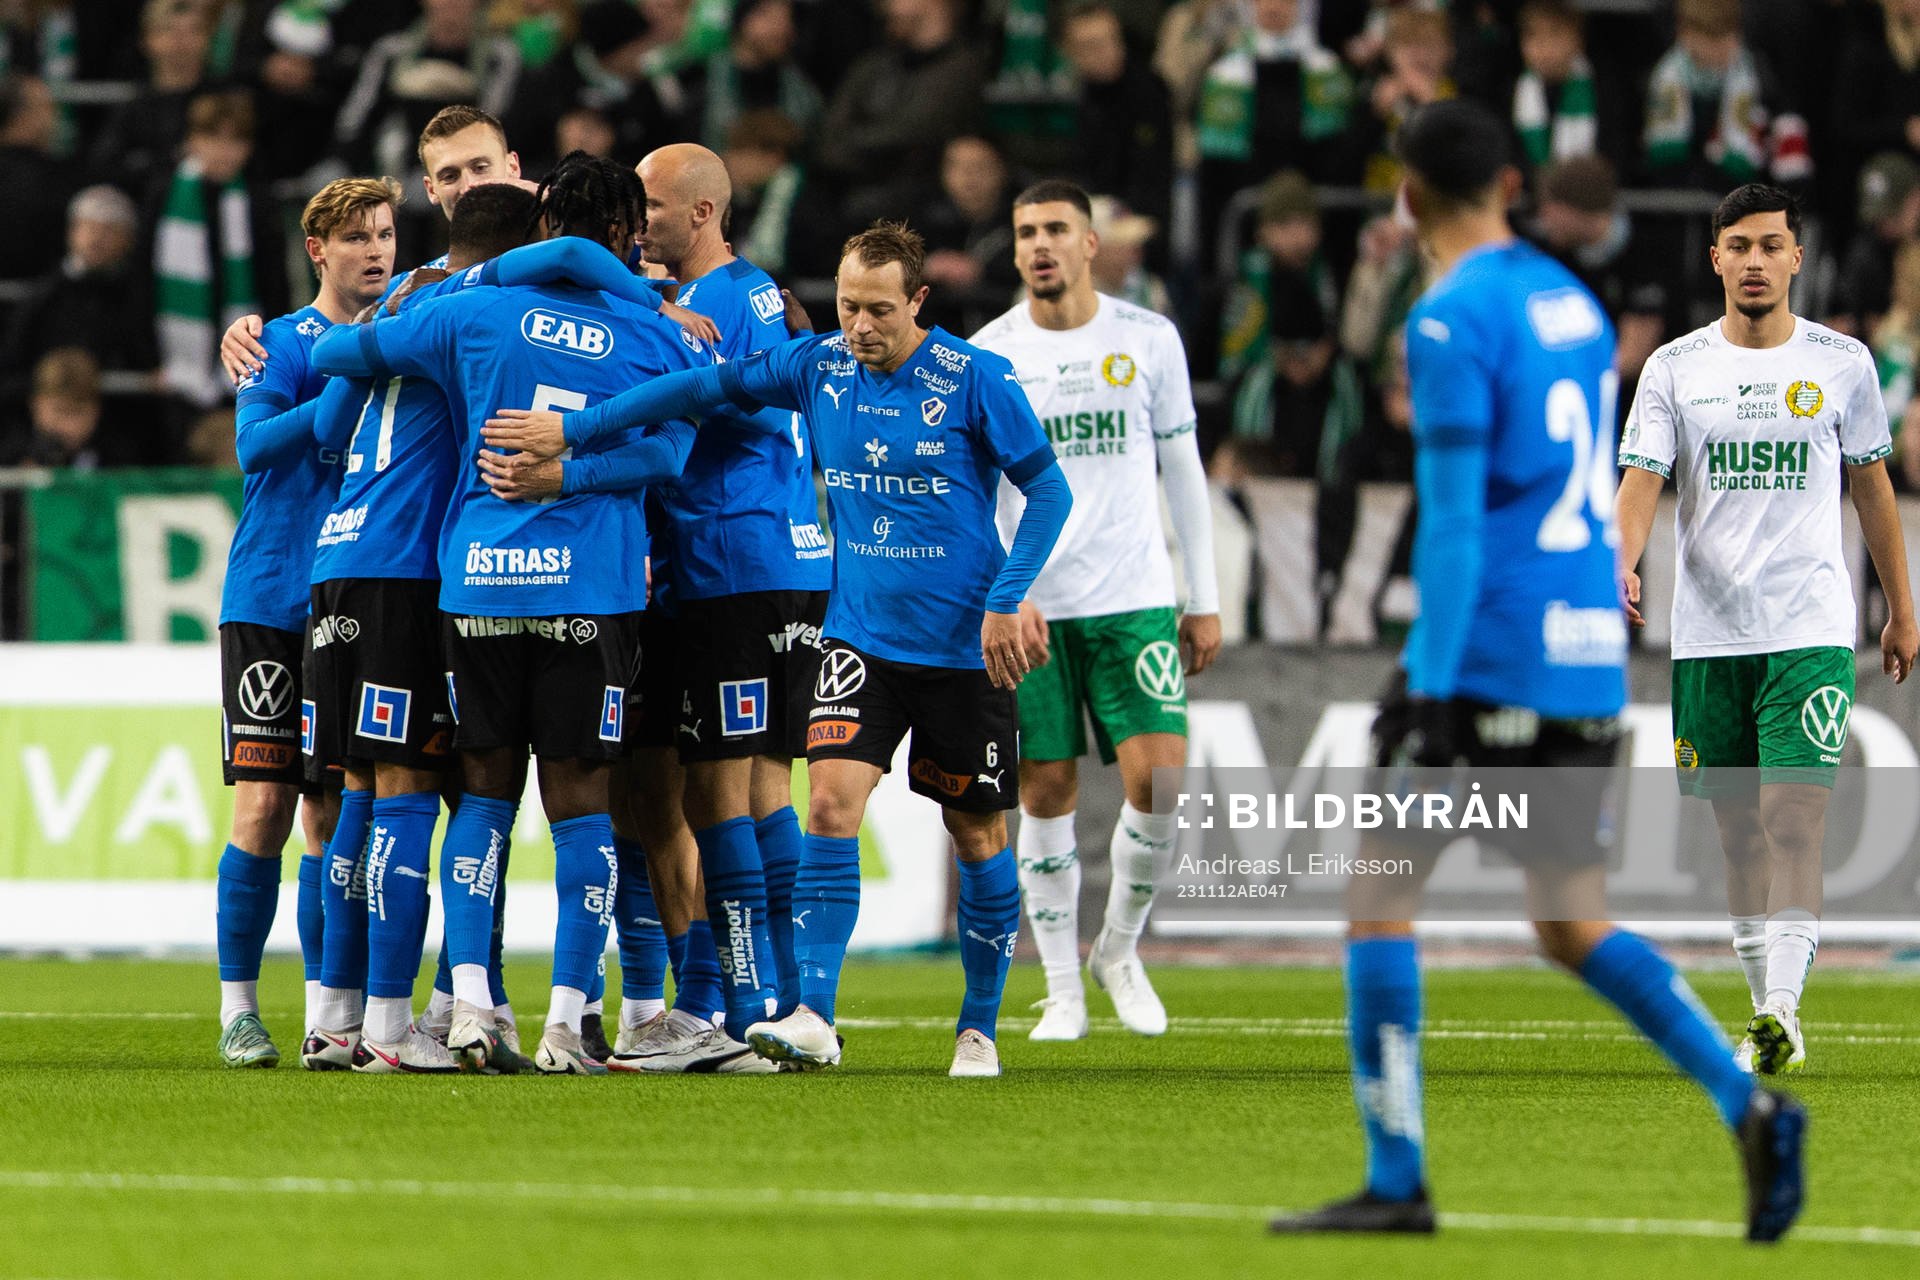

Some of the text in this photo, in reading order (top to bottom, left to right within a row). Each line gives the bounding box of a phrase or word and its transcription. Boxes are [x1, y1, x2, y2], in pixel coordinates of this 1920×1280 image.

[528, 312, 606, 354] EAB
[1807, 331, 1863, 357] sesol
[930, 343, 972, 367] sport
[936, 357, 964, 375] ringen
[1690, 397, 1721, 407] CRAFT
[1753, 389, 1777, 397] SPORT
[857, 404, 901, 417] GETINGE
[915, 448, 941, 456] STAD
[916, 440, 945, 449] HALM
[1707, 441, 1809, 475] HUSKI
[824, 467, 951, 495] GETINGE
[1710, 474, 1806, 491] CHOCOLATE
[465, 542, 560, 573] ÖSTRAS
[464, 575, 571, 586] STENUGNSBAGERIET
[986, 741, 998, 768] 6
[330, 854, 354, 887] GN
[453, 856, 481, 884] GN
[584, 885, 605, 913] GN
[598, 845, 619, 927] Transport
[743, 907, 752, 933] France
[721, 900, 752, 987] Transport
[1005, 931, 1018, 958] GN
[717, 947, 734, 974] GN
